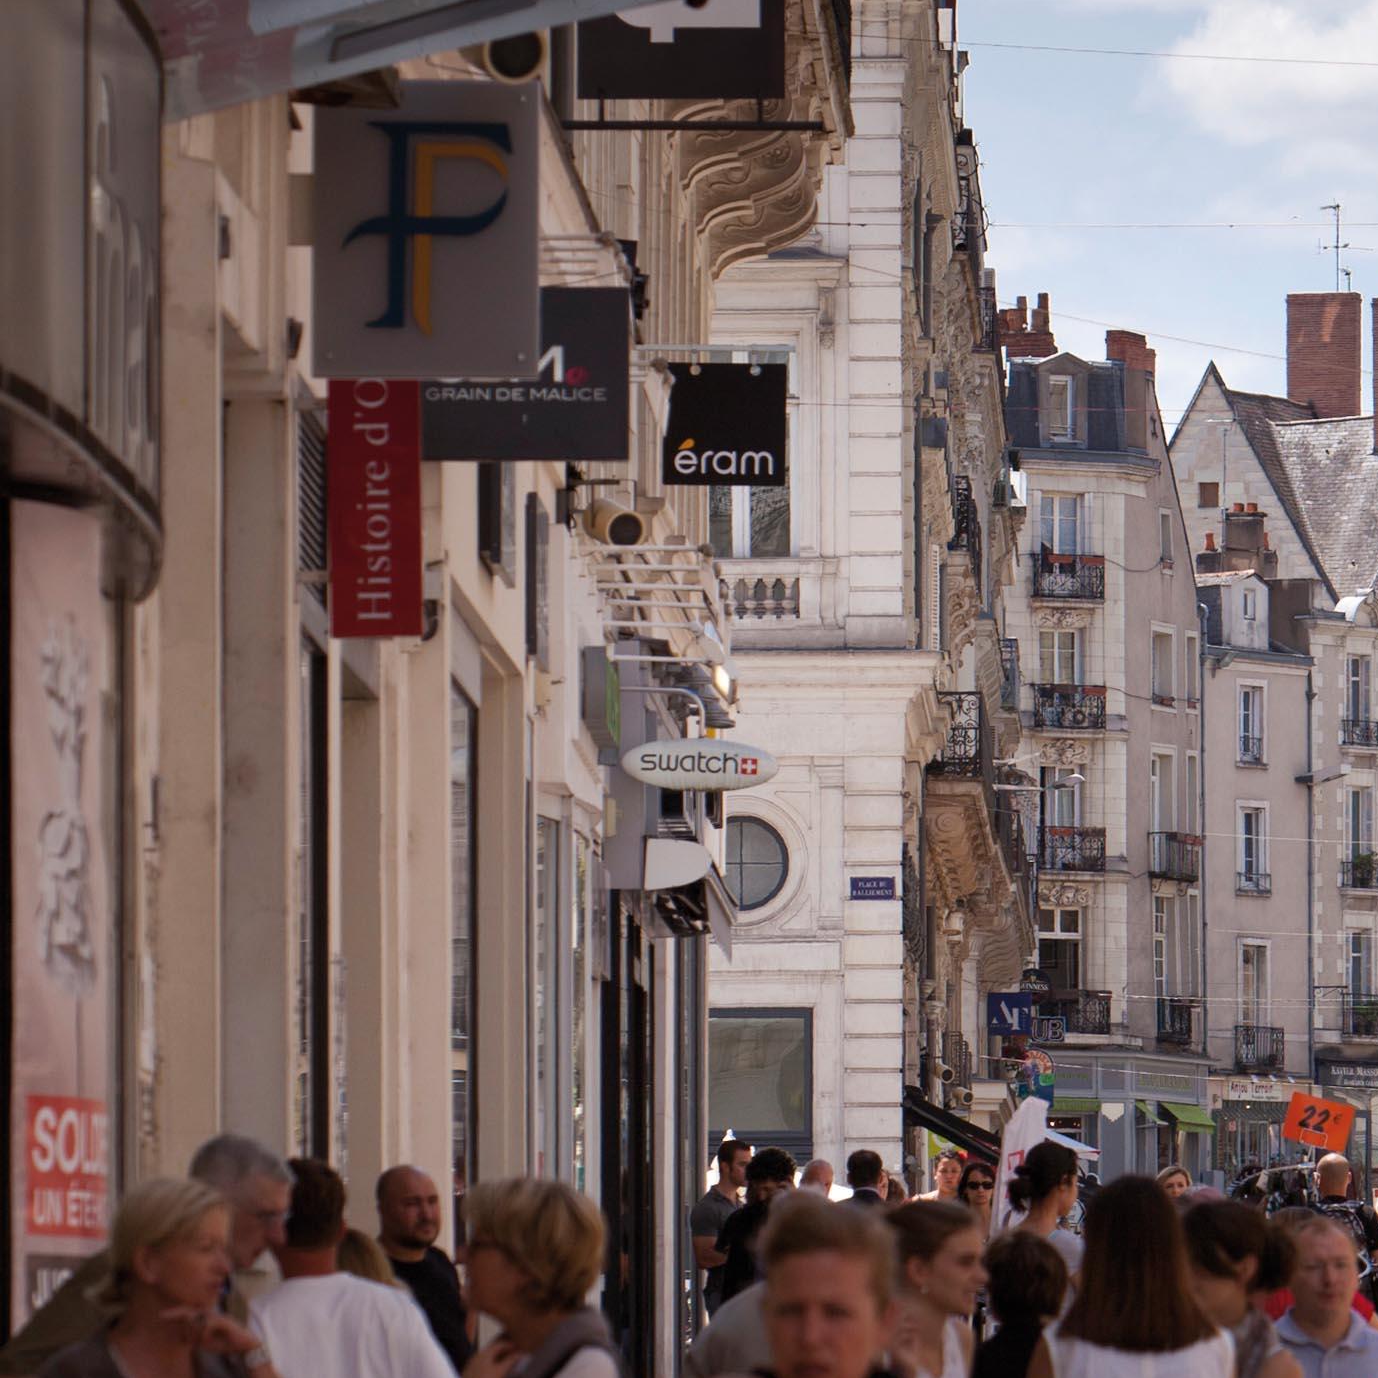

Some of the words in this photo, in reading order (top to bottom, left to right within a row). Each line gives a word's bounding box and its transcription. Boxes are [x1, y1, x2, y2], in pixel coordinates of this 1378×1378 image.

[425, 387, 491, 402] GRAIN
[495, 387, 526, 402] DE
[529, 387, 608, 402] MALICE
[353, 377, 390, 447] d'O
[674, 438, 775, 475] éram
[356, 460, 393, 621] Histoire
[640, 751, 738, 774] swatch
[1031, 1018, 1065, 1043] UB
[1298, 1105, 1331, 1133] 22
